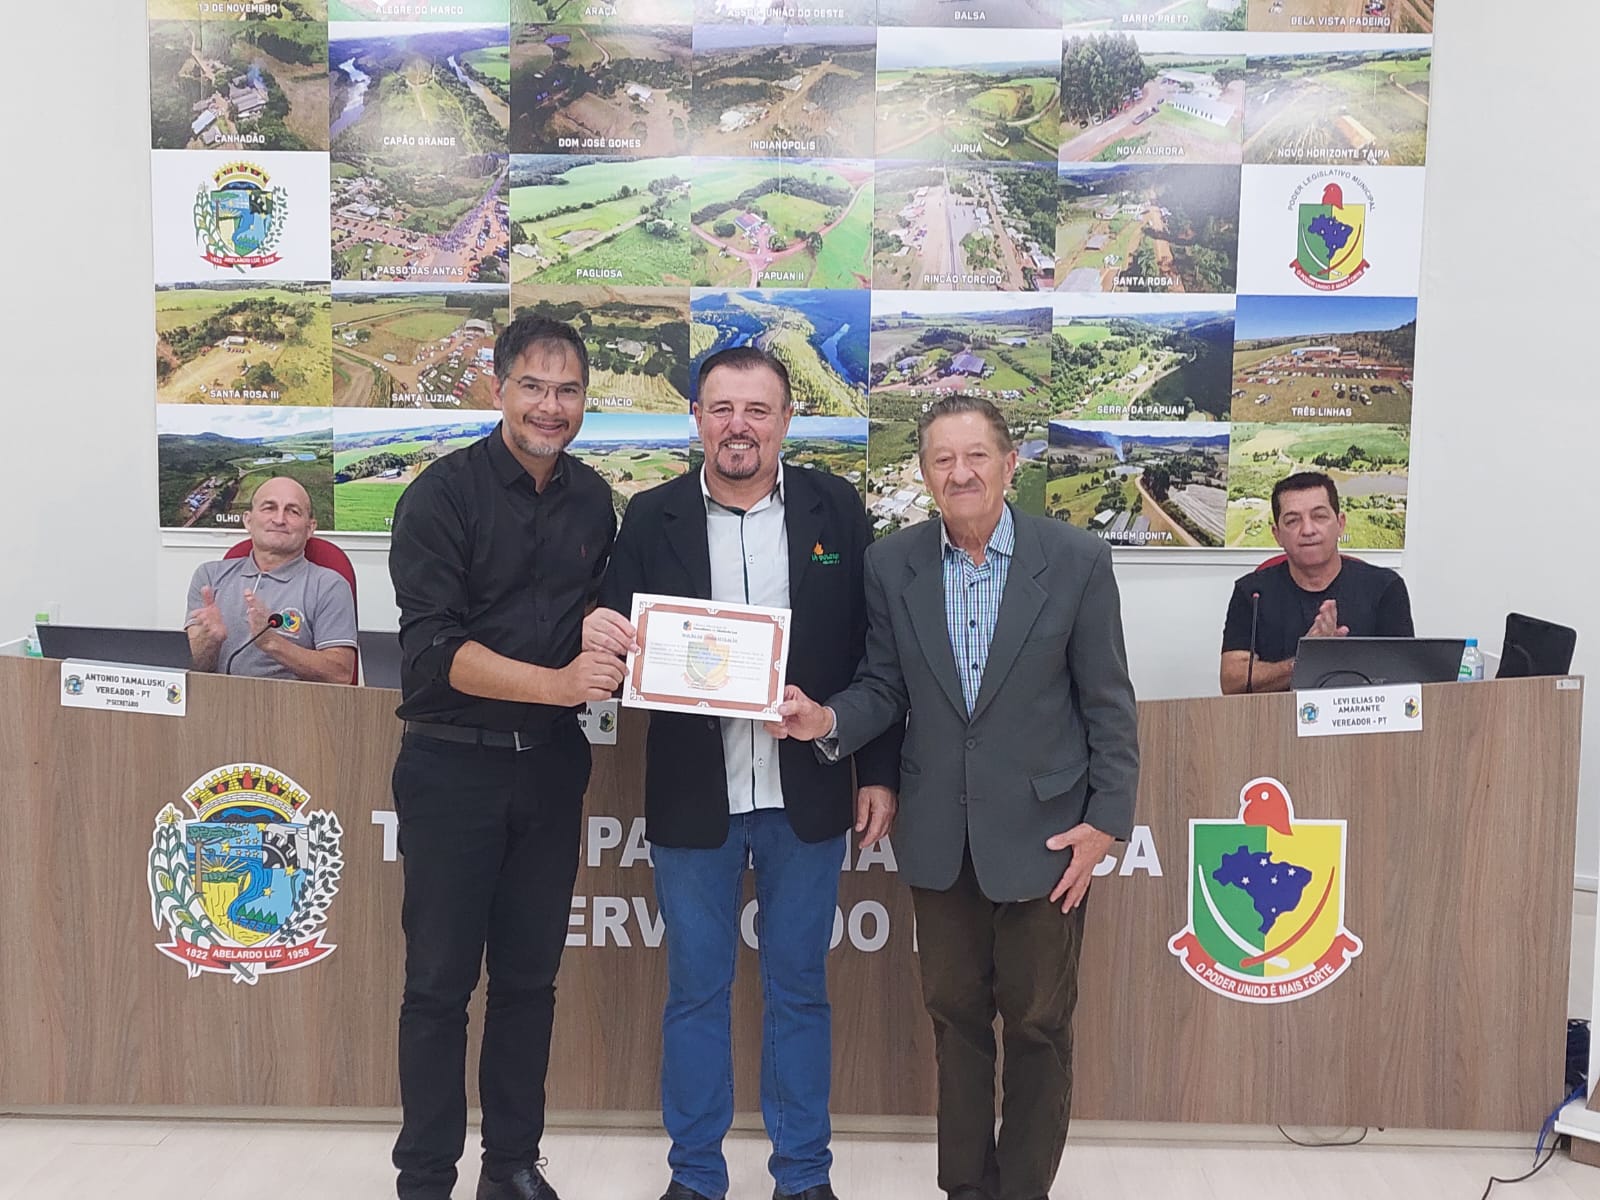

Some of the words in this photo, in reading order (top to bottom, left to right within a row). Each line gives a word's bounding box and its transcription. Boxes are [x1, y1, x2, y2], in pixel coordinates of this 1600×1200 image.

[212, 4, 224, 12] DE
[227, 4, 278, 14] NOVEMBRO
[766, 6, 794, 17] UNIÃO
[798, 8, 810, 17] DO
[814, 9, 844, 17] OESTE
[954, 12, 986, 20] BALSA
[1122, 14, 1154, 22] BARRO
[1158, 14, 1189, 24] PRETO
[1291, 16, 1315, 26] BELA
[1318, 16, 1346, 26] VISTA
[1349, 16, 1391, 27] PADEIRO
[214, 132, 266, 144] CANHADÃO
[383, 134, 416, 146] CAPÃO
[418, 136, 456, 146] GRANDE
[558, 138, 579, 148] DOM
[581, 136, 606, 148] JOSÉ
[608, 139, 642, 148] GOMES
[750, 139, 816, 150] INDIANÓPOLIS
[952, 142, 982, 153] JURUÁ
[1116, 146, 1142, 155] NOVA
[1146, 146, 1184, 156] AURORA
[1278, 149, 1304, 158] NOVO
[1306, 149, 1359, 158] HORIZONTE
[1362, 149, 1390, 158] TAIPA
[1288, 185, 1304, 211] PODER
[1302, 168, 1351, 186] LEGISLATIVO
[1352, 176, 1376, 212] MUNICIPAL
[377, 266, 408, 276] PASSO
[410, 266, 427, 276] DAS
[430, 266, 464, 276] ANTAS
[576, 268, 622, 278] PAGLIOSA
[758, 272, 795, 281] PAPUAN
[797, 272, 804, 281] II
[924, 273, 960, 284] RINCÃO
[962, 274, 1002, 285] TORCIDO
[1114, 276, 1144, 286] SANTA
[1148, 276, 1173, 286] ROSA
[210, 390, 240, 399] SANTA
[242, 390, 268, 400] ROSA
[392, 394, 422, 402] SANTA
[426, 394, 451, 402] LUZIA
[602, 394, 632, 406] INÁCIO
[1098, 405, 1128, 414] SERRA
[1130, 406, 1143, 414] DA
[1146, 406, 1184, 415] PAPUAN
[1291, 407, 1315, 417] TRÊS
[1318, 408, 1352, 417] LINHAS
[216, 514, 240, 522] OLHO
[1098, 532, 1135, 540] VARGEM
[1139, 532, 1172, 540] BONITA
[85, 673, 119, 683] ANTONIO
[122, 676, 165, 687] TAMALUSKI
[96, 686, 134, 696] VEREADOR
[142, 690, 150, 698] PT
[1352, 696, 1373, 704] ELIAS
[1338, 705, 1380, 713] AMARANTE
[1332, 718, 1370, 727] VEREADOR
[1378, 717, 1387, 725] PT
[185, 948, 209, 960] 1822
[212, 949, 262, 959] ABELARDO
[264, 950, 282, 959] LUZ
[287, 948, 310, 960] 1958
[1196, 963, 1205, 974] O
[1204, 967, 1236, 992] PODER
[1237, 983, 1268, 997] UNIDO
[1270, 981, 1277, 996] É
[1279, 980, 1304, 995] MAIS
[1303, 964, 1335, 988] FORTE
